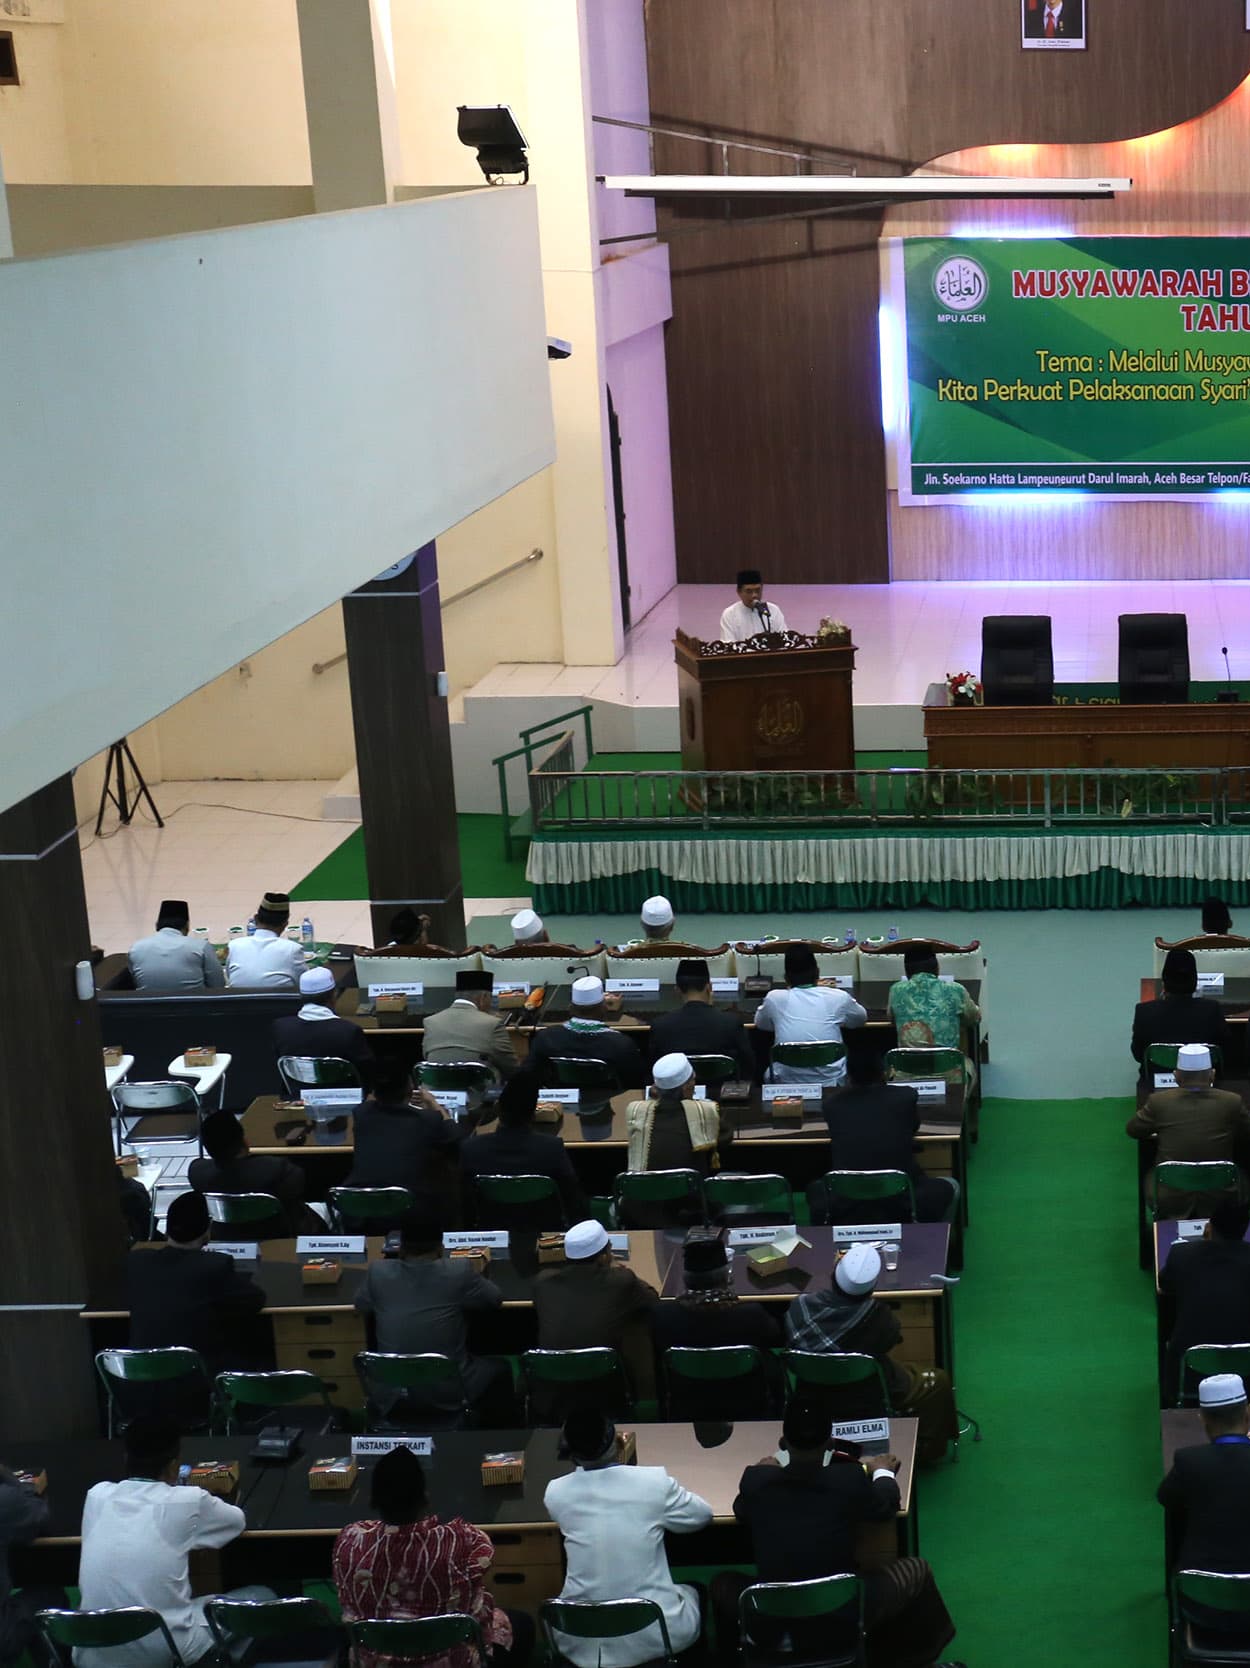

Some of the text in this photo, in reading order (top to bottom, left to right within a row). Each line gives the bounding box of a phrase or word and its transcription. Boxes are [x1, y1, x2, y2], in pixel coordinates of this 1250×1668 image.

[1013, 268, 1223, 298] MUSYAWARAH
[937, 314, 986, 322] MPU ACEH
[1036, 350, 1093, 372] Tema
[1109, 350, 1179, 372] Melalui
[938, 379, 978, 401] Kita
[984, 379, 1062, 401] Perkuat
[1070, 379, 1194, 401] Pelaksanaan
[924, 473, 940, 485] Jln.
[943, 473, 987, 485] Soekarno
[990, 473, 1015, 485] Hatta
[1018, 473, 1086, 487] Lampeuneurut
[1089, 472, 1114, 484] Darul
[1116, 472, 1152, 485] Imarah,
[1154, 472, 1179, 484] Aceh
[1180, 472, 1205, 484] Besar
[835, 1424, 884, 1436] RAMLI ELMA
[357, 1442, 391, 1450] INSTANSI
